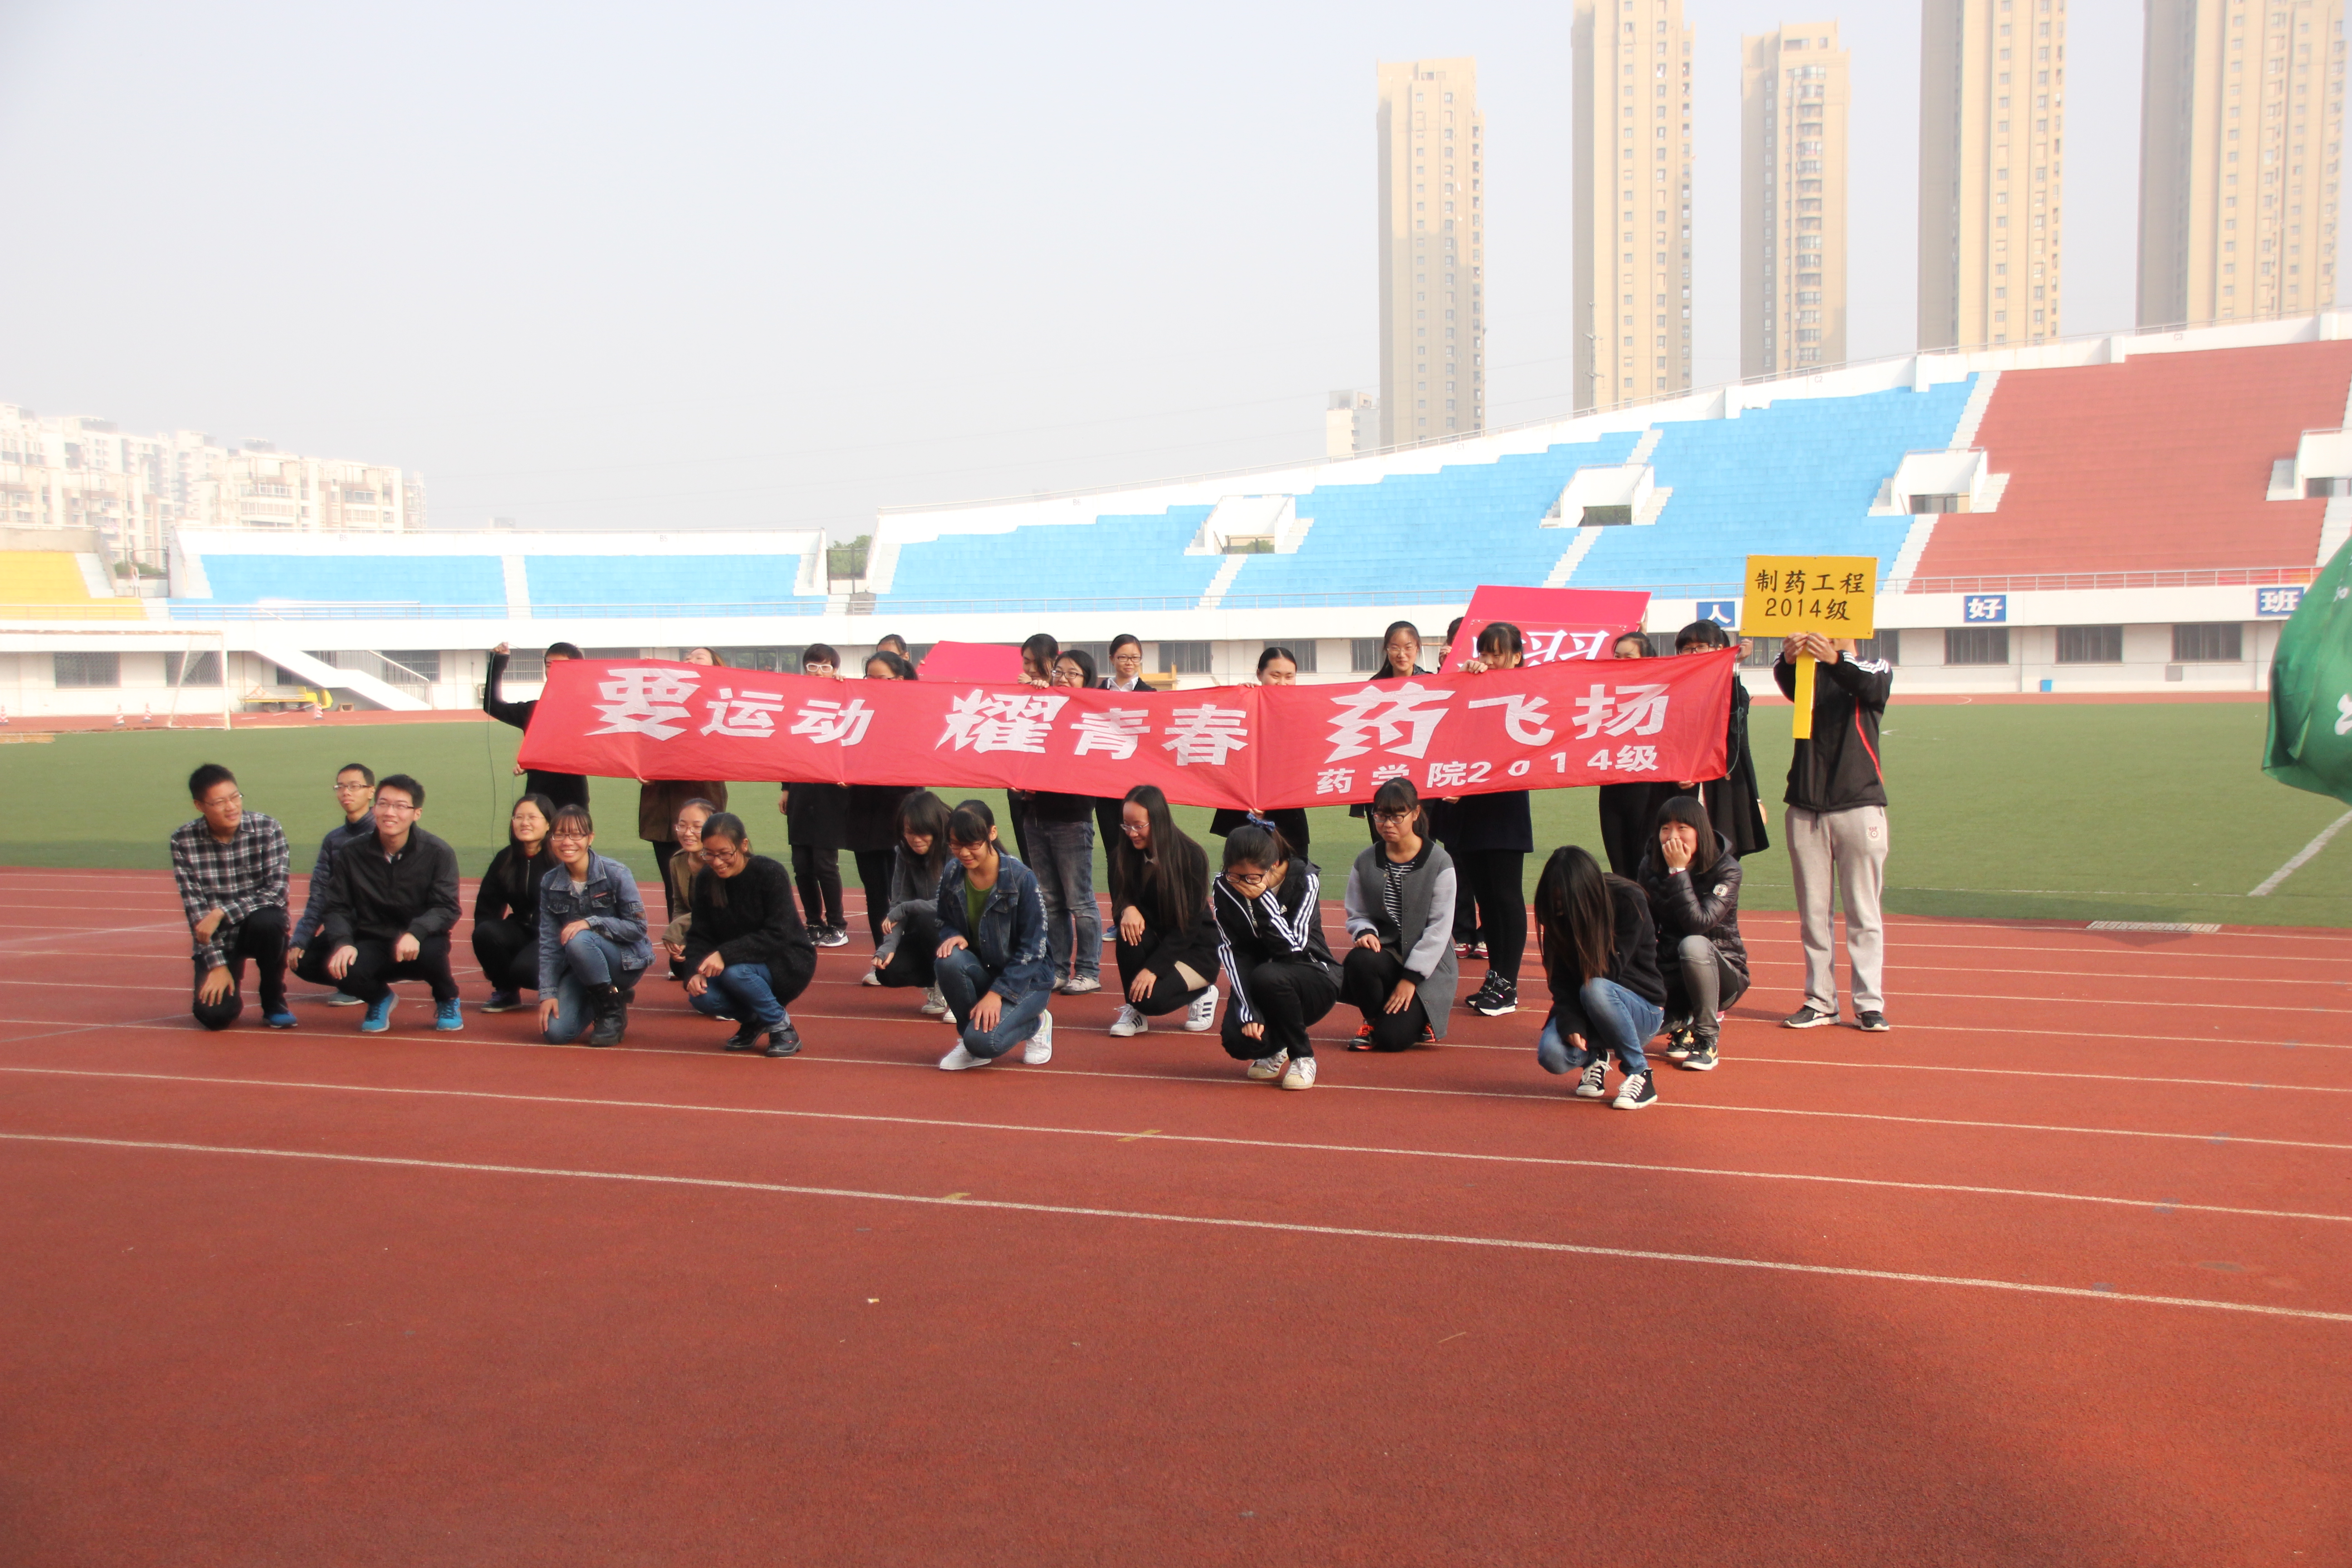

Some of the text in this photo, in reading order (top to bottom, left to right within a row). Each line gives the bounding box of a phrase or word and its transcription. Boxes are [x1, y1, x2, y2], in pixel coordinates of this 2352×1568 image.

[1754, 568, 1865, 595] 制药工程
[1764, 598, 1851, 621] 2014级
[1967, 598, 2003, 620] 好
[2260, 590, 2299, 613] 班
[1707, 604, 1732, 624] 人
[583, 667, 1670, 766] 要运动 耀青春 药飞扬
